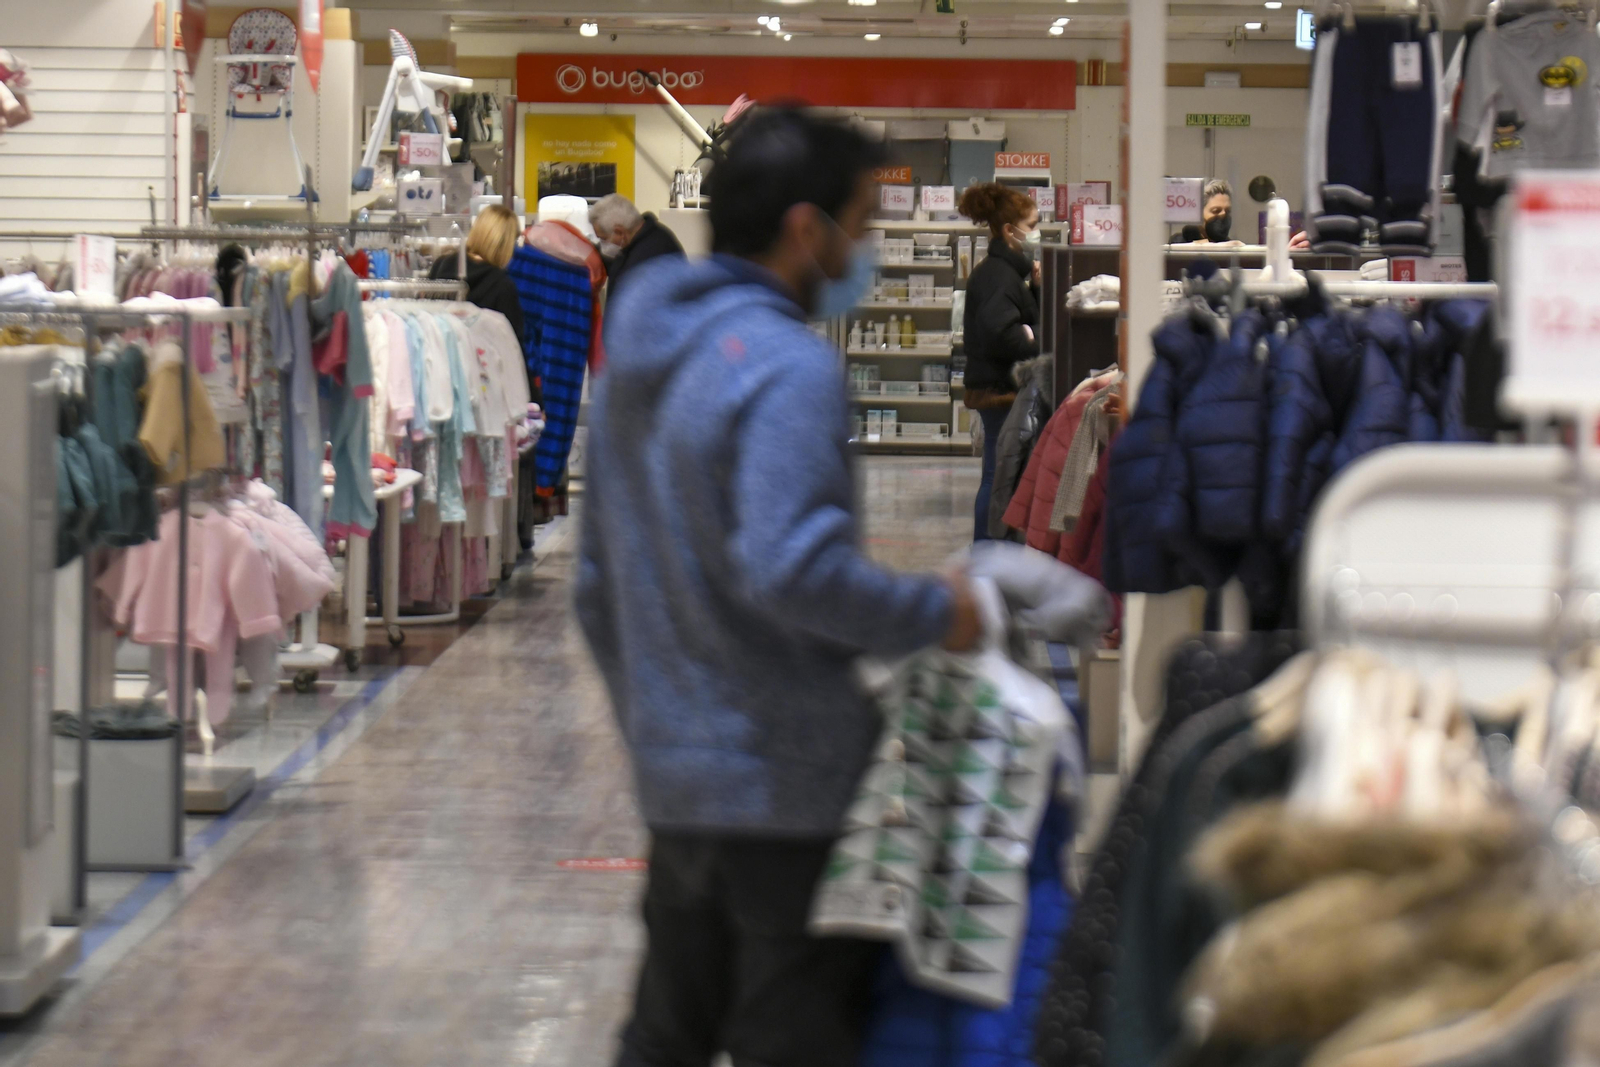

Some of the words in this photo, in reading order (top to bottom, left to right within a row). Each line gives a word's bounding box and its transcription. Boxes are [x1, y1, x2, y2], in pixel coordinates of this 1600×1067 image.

[592, 66, 704, 94] bugaboo
[1187, 114, 1206, 125] SALIDA
[1207, 114, 1214, 125] DE
[1215, 114, 1250, 126] EMERGENCIA
[412, 147, 439, 157] -50%
[997, 153, 1046, 166] STOKKE
[872, 167, 907, 180] OKKE
[890, 194, 907, 203] -15%
[930, 194, 950, 203] -25%
